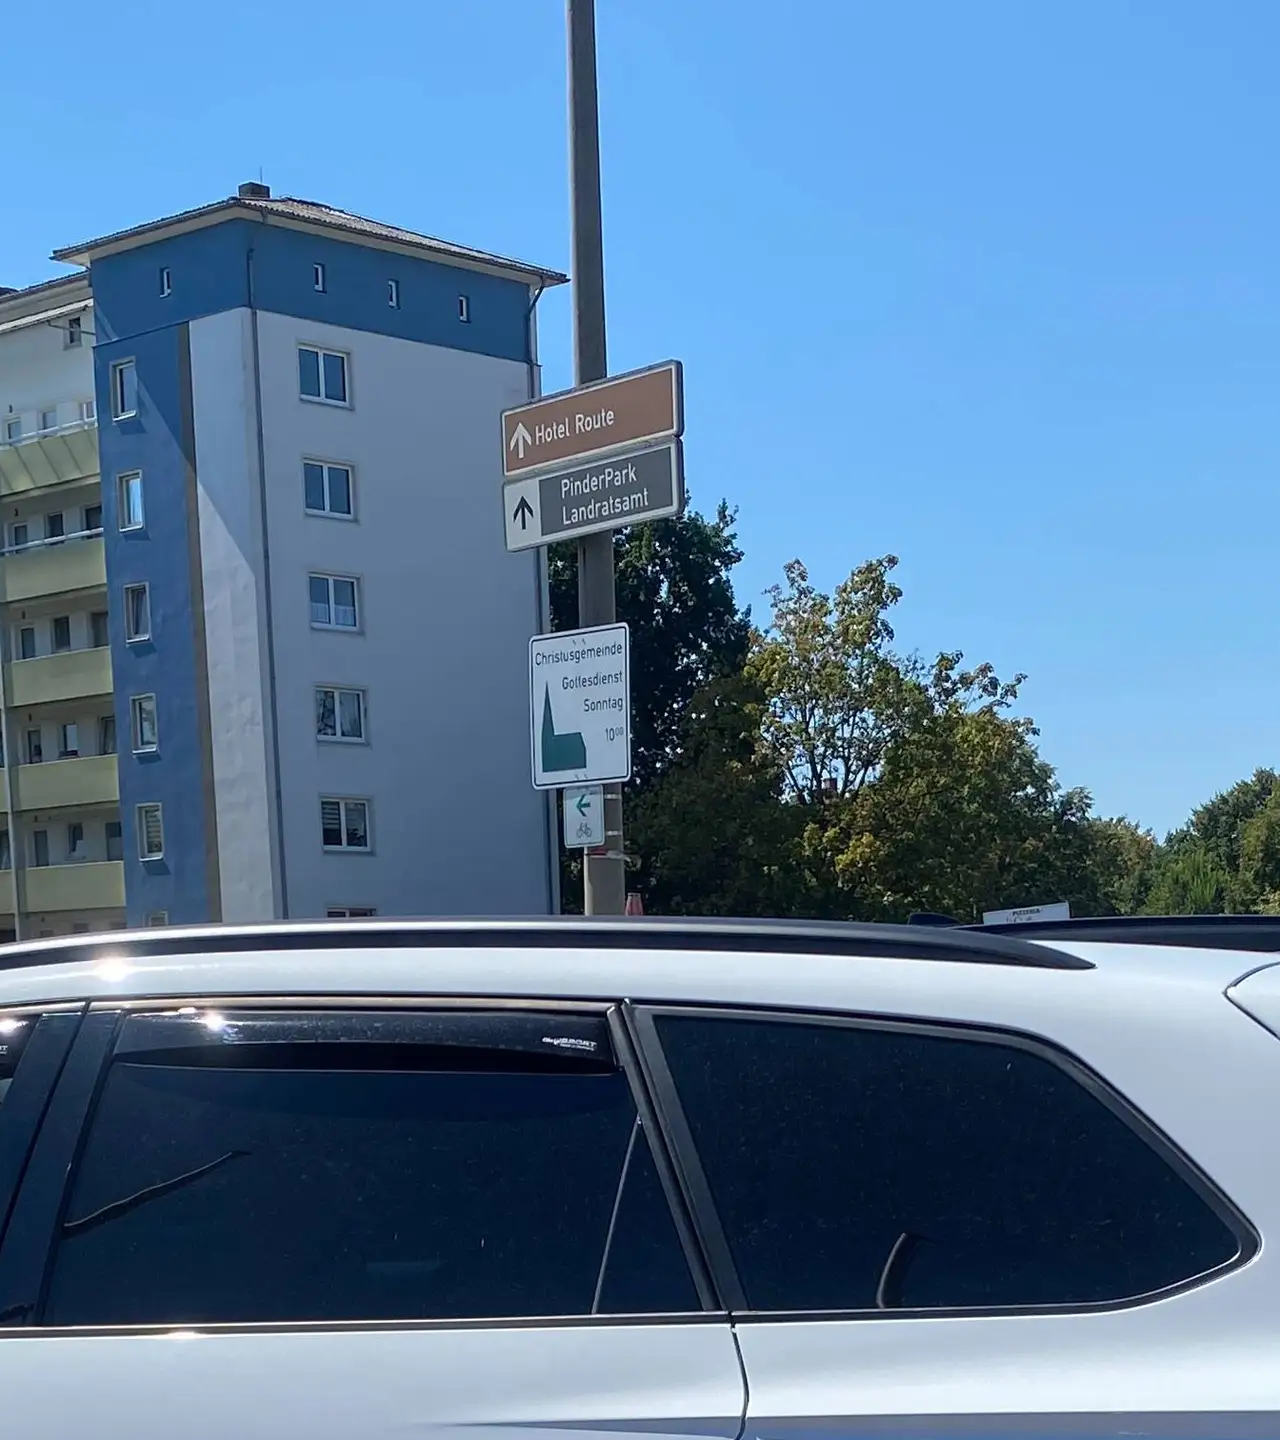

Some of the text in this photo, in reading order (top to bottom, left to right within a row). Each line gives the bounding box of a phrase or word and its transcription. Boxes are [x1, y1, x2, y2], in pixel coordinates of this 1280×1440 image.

[535, 409, 615, 446] Hotel Route
[561, 463, 637, 498] PinderPark
[563, 488, 648, 525] Landratsamt
[535, 641, 623, 666] Christusgemeinde
[562, 670, 623, 690] Gottesdienst
[583, 696, 624, 712] Sonntag
